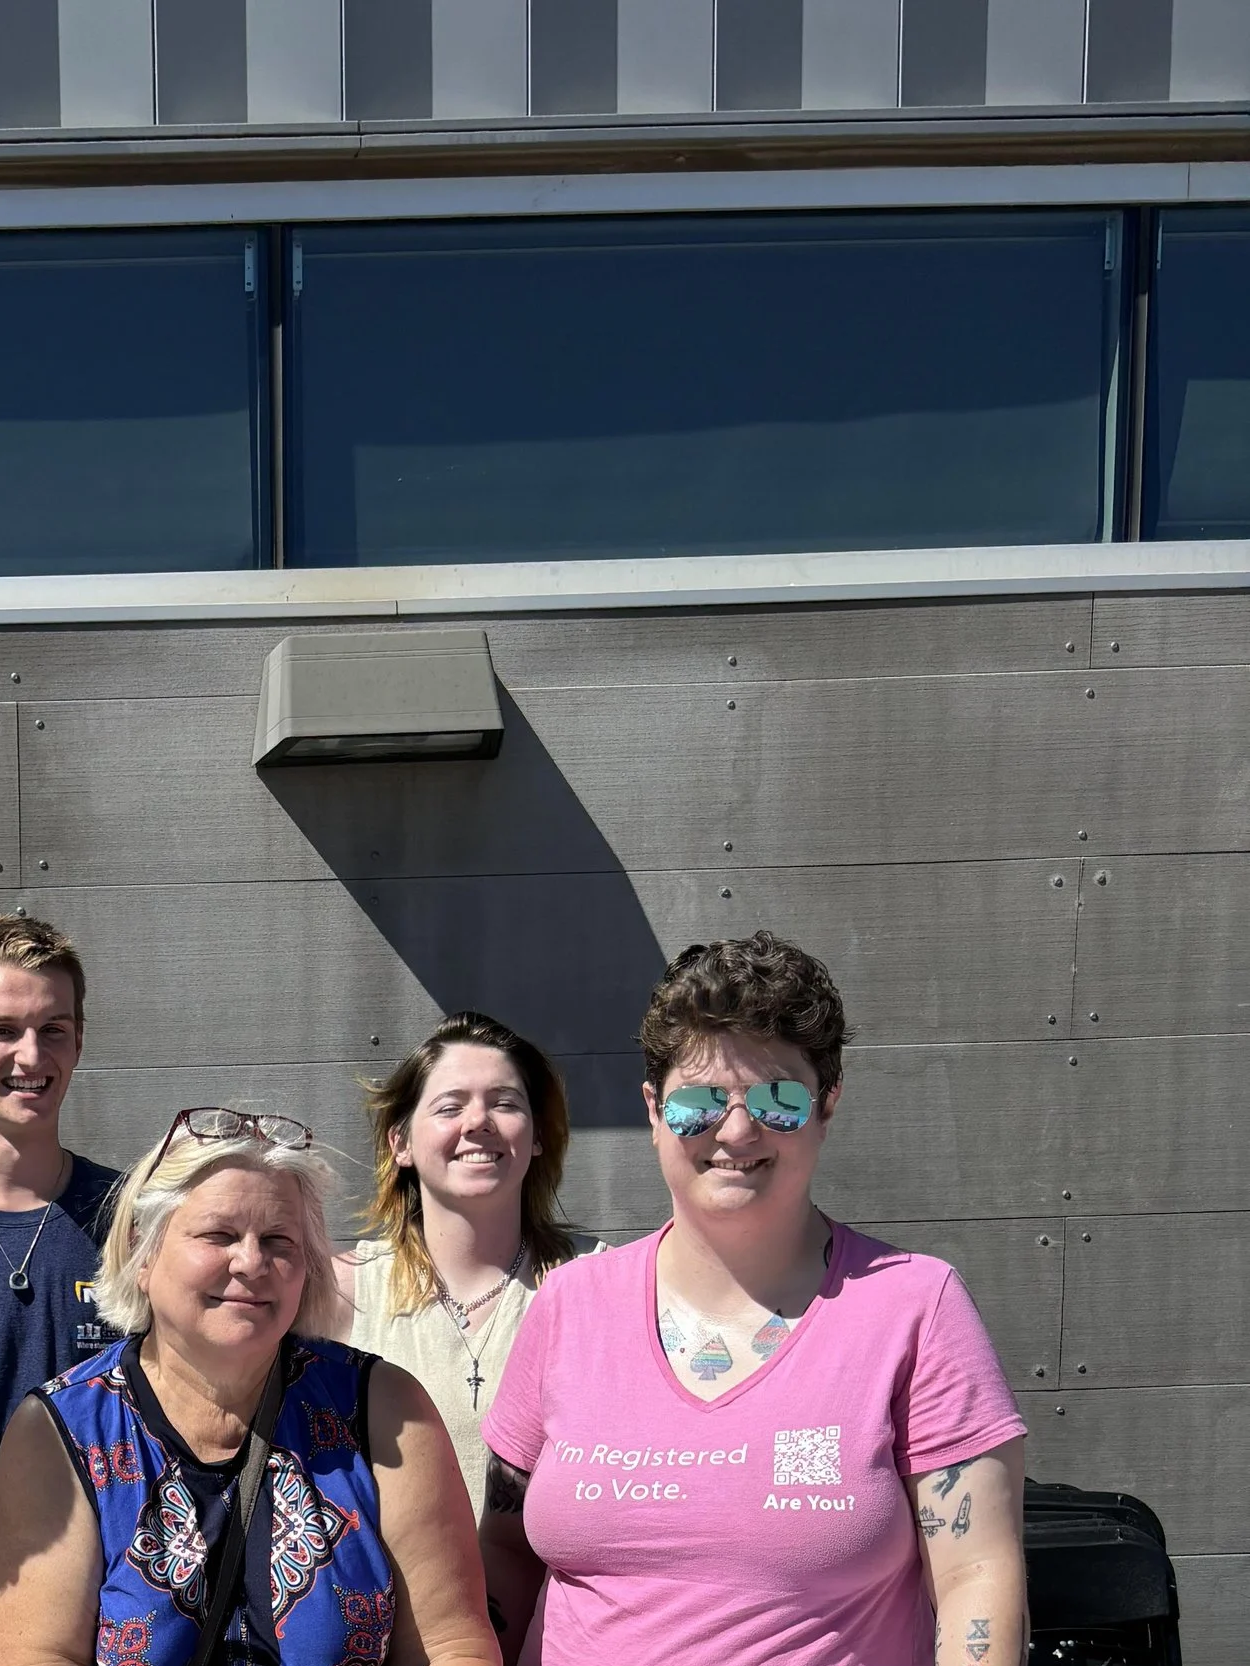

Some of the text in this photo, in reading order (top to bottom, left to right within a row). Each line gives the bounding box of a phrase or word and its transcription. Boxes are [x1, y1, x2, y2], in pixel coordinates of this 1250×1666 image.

[553, 1441, 749, 1471] I'm Registered
[575, 1480, 689, 1501] to Vote.
[763, 1494, 856, 1513] Are You?
